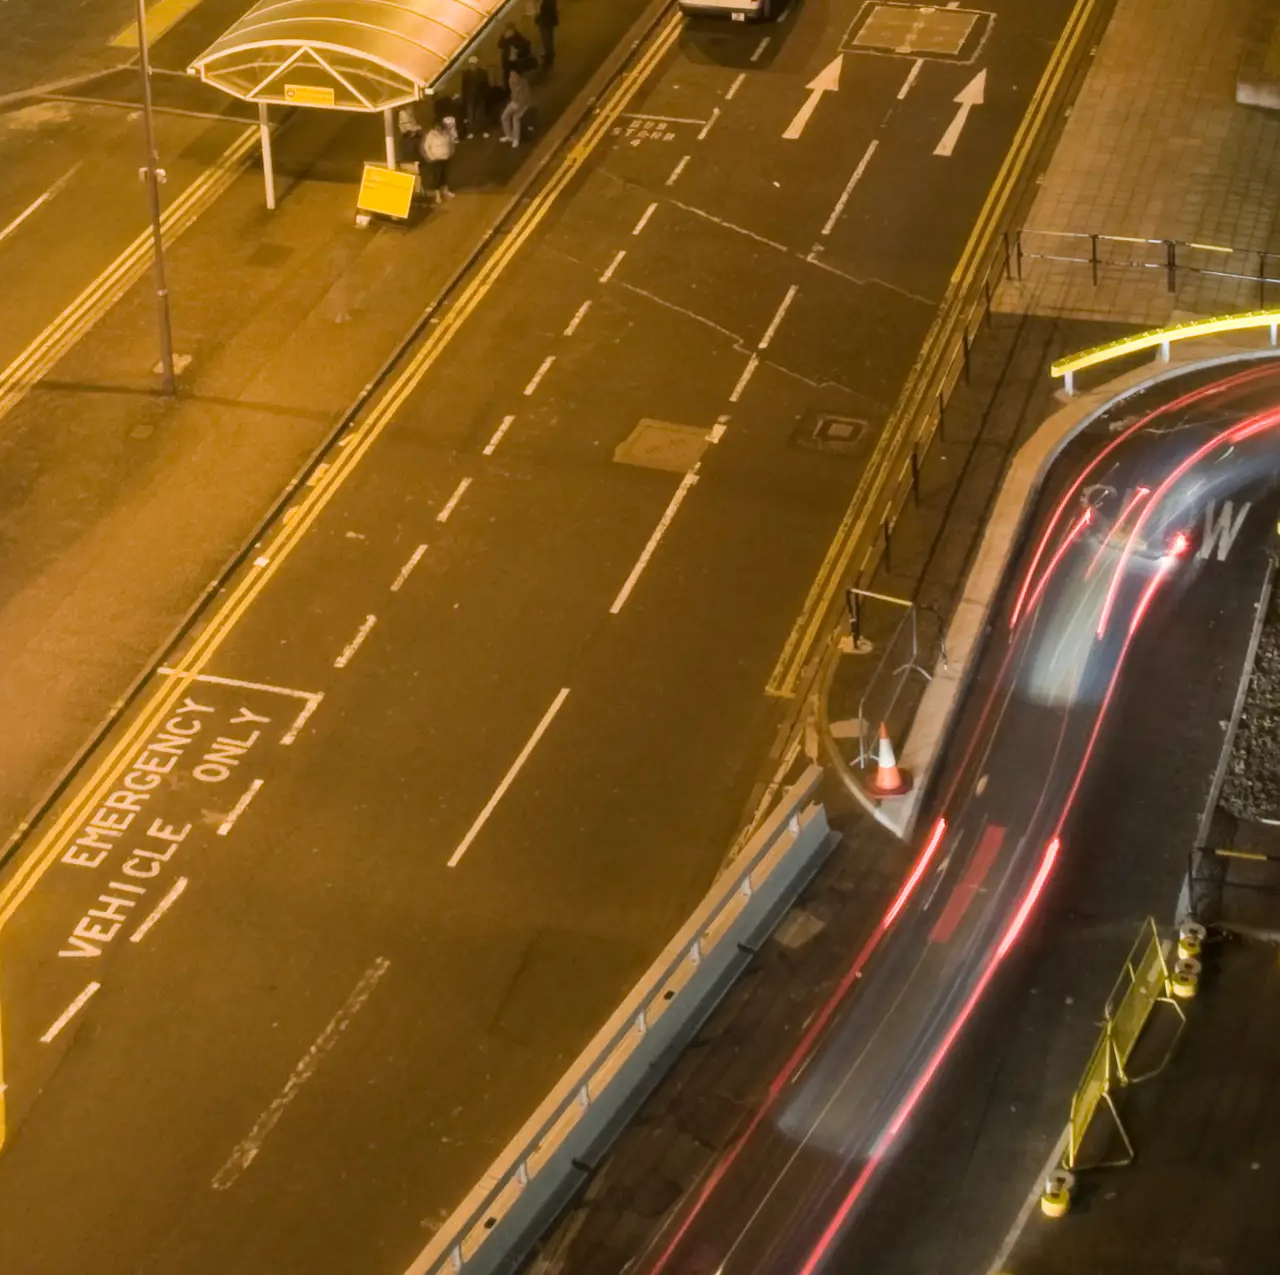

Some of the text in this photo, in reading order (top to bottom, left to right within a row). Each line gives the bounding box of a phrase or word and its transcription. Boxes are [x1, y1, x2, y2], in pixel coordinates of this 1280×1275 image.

[58, 707, 272, 959] VEHICLE ONLY
[61, 696, 216, 869] EMERGENCY
